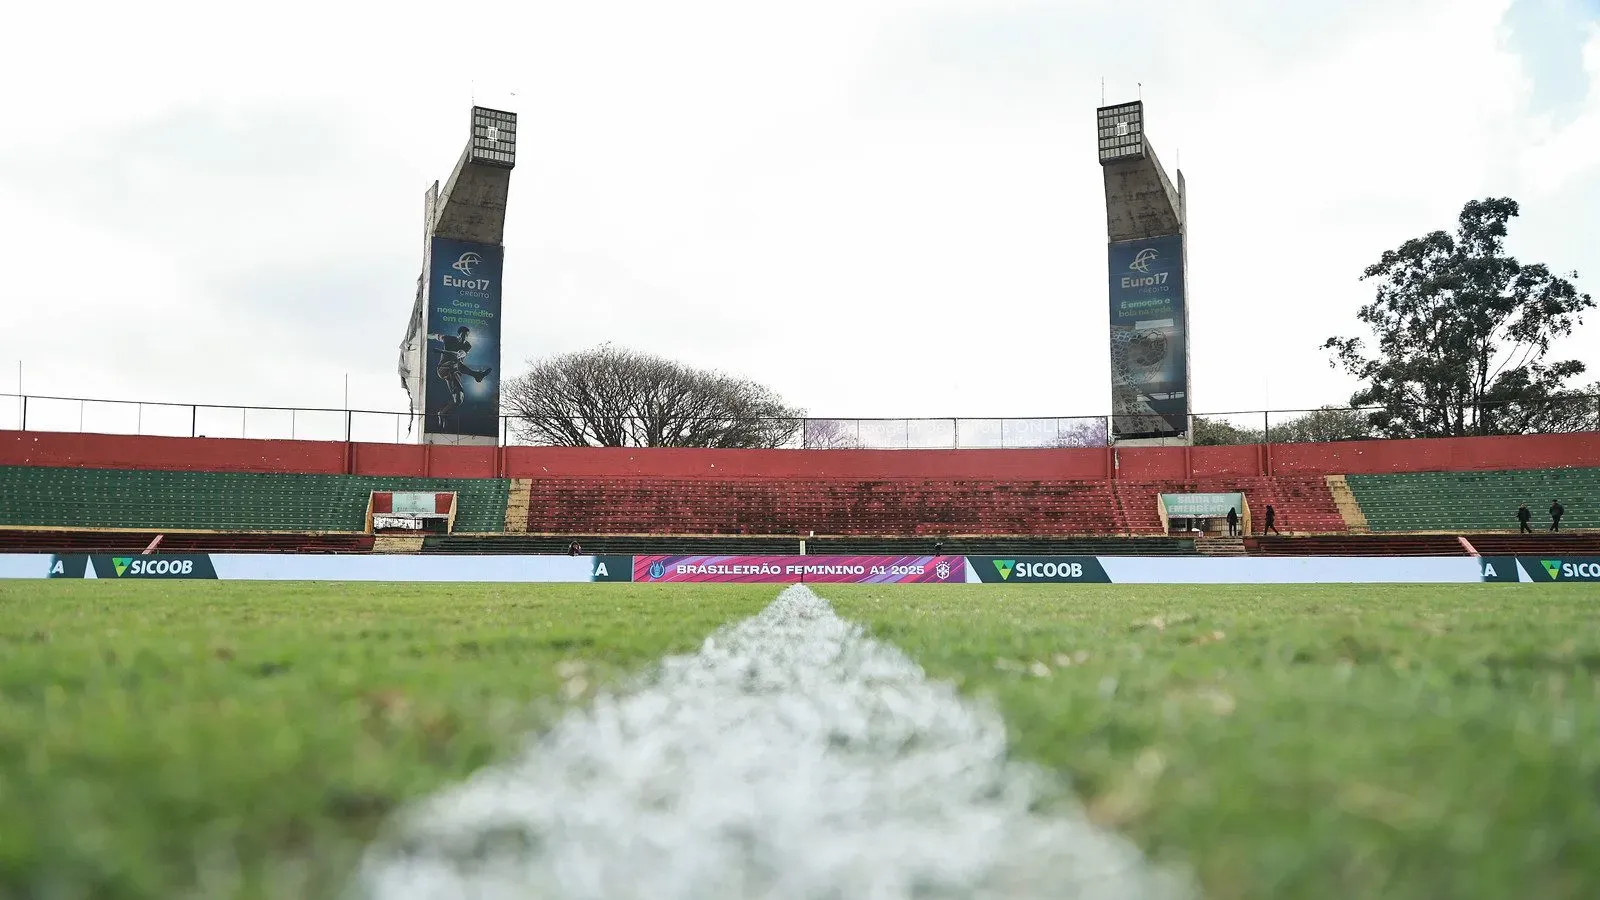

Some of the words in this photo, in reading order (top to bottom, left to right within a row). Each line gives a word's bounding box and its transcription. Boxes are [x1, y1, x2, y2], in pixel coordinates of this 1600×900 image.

[443, 274, 490, 290] Euro17
[1121, 272, 1169, 288] Euro17
[452, 299, 473, 308] Com
[437, 307, 463, 315] nosso
[464, 309, 494, 318] crédito
[442, 315, 456, 323] em
[130, 560, 193, 575] SICOOB
[676, 563, 782, 575] BRASILEIRÃO
[785, 565, 865, 575] FEMININO
[869, 565, 887, 575] A1
[891, 565, 925, 575] 2025
[1015, 562, 1084, 577] SICOOB
